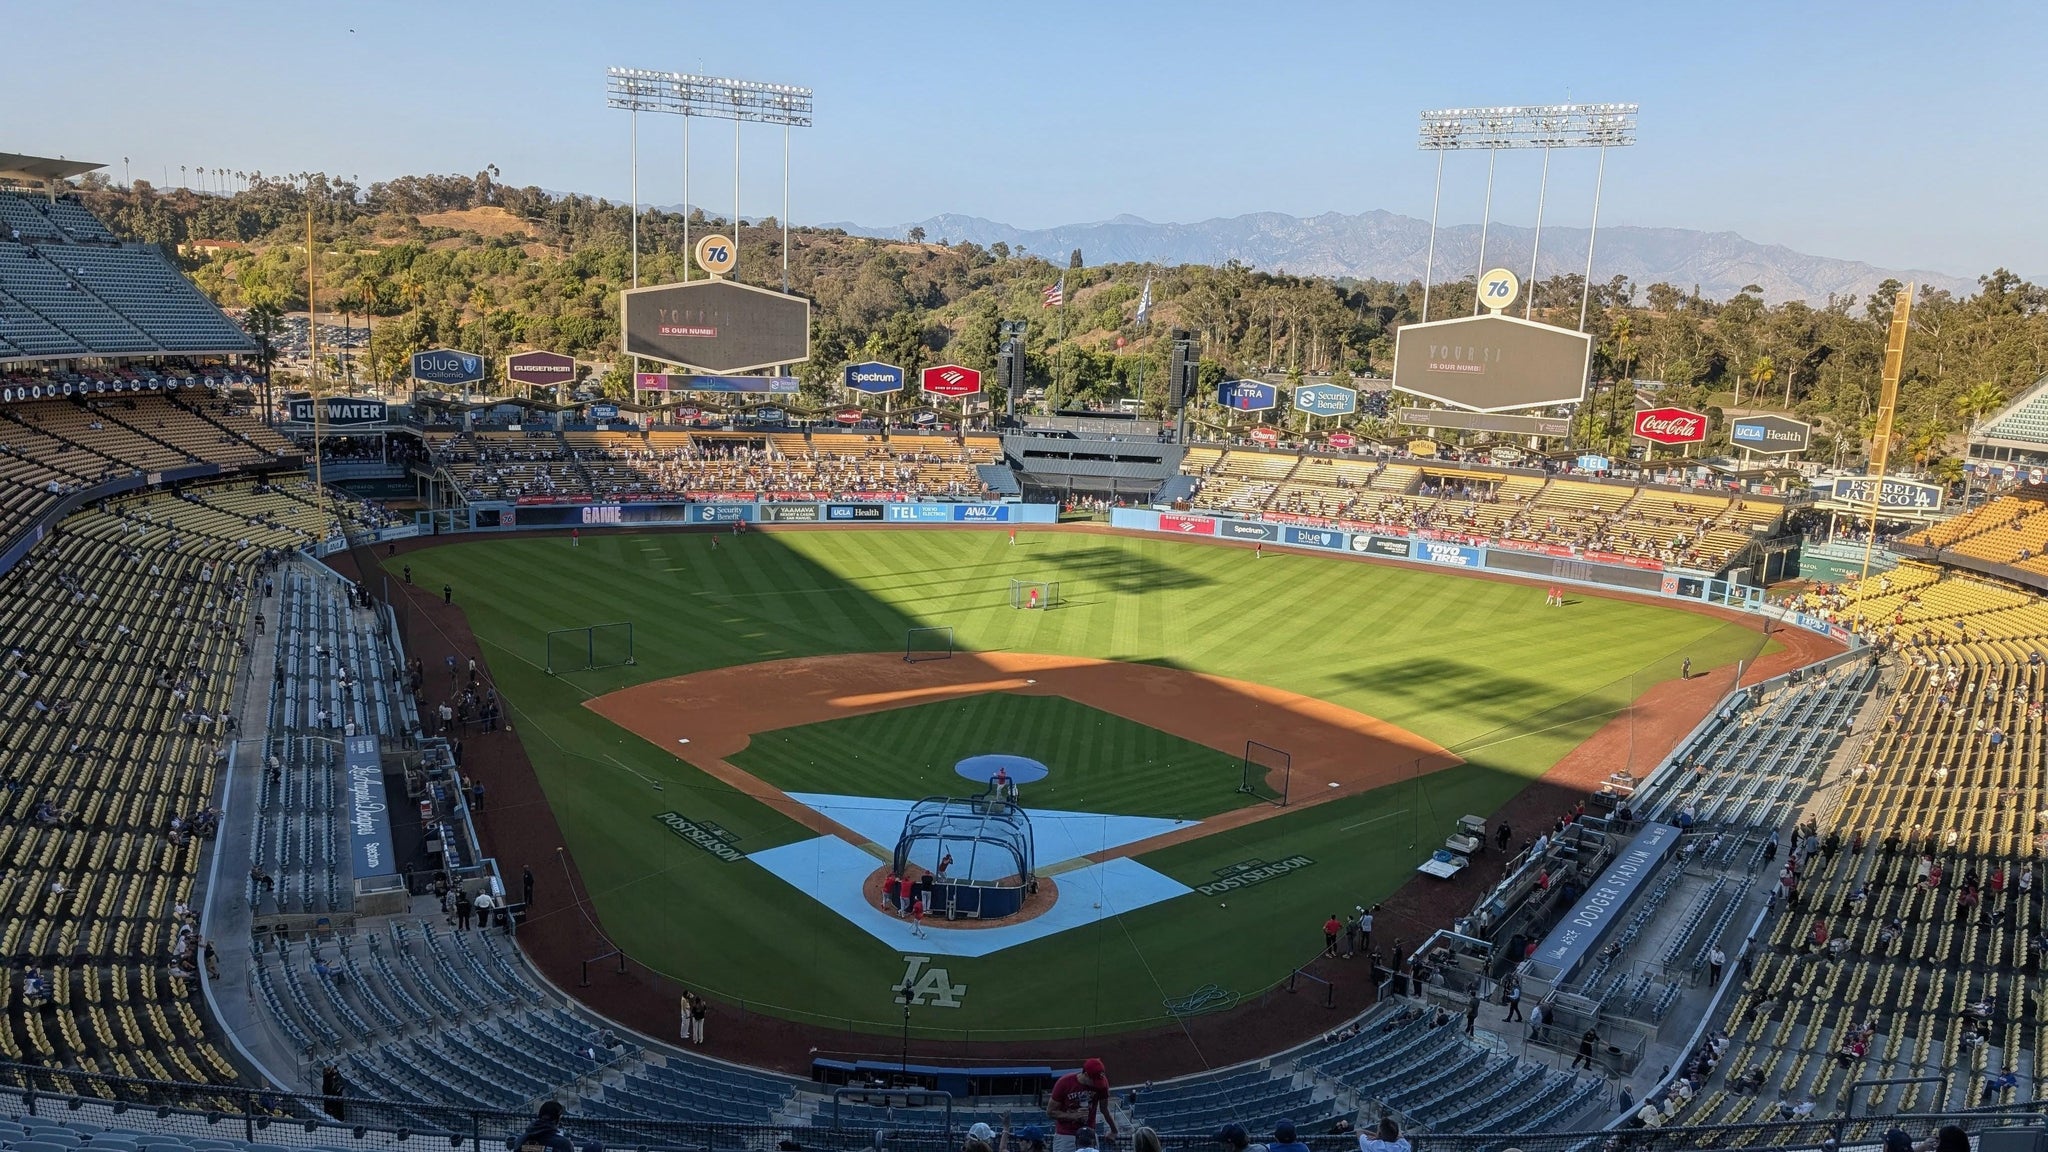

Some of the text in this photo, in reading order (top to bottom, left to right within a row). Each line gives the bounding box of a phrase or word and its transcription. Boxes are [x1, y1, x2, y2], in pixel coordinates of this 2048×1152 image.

[707, 245, 729, 263] 76
[1487, 280, 1510, 297] 76
[420, 356, 459, 371] blue
[427, 371, 464, 379] california
[852, 372, 894, 383] Spectrum
[1230, 388, 1262, 398] ULTRA
[1318, 392, 1350, 402] Security
[296, 404, 380, 418] CUTWATER
[1318, 400, 1345, 410] Benefit
[1640, 414, 1700, 437] Coca-Cola
[1737, 428, 1802, 442] UCLA Health
[1582, 458, 1606, 468] TEL
[1842, 489, 1910, 506] JALSCO
[582, 506, 622, 524] GAME
[717, 506, 743, 515] Security
[855, 508, 879, 516] Health
[892, 507, 917, 518] TEL
[965, 507, 987, 516] ANA
[502, 515, 513, 523] 76
[1234, 525, 1264, 535] Spectrum
[1298, 530, 1320, 541] blue
[1426, 544, 1460, 556] TOYO
[1431, 553, 1469, 565] TIRES
[348, 776, 382, 806] Angeles
[350, 803, 385, 835] Dodgers
[656, 812, 746, 861] POSTSEASON
[364, 842, 380, 868] Spectrum
[1196, 856, 1313, 895] POSTSEASON
[1573, 850, 1652, 927] DODGER STADIUM
[891, 955, 968, 1008] LA
